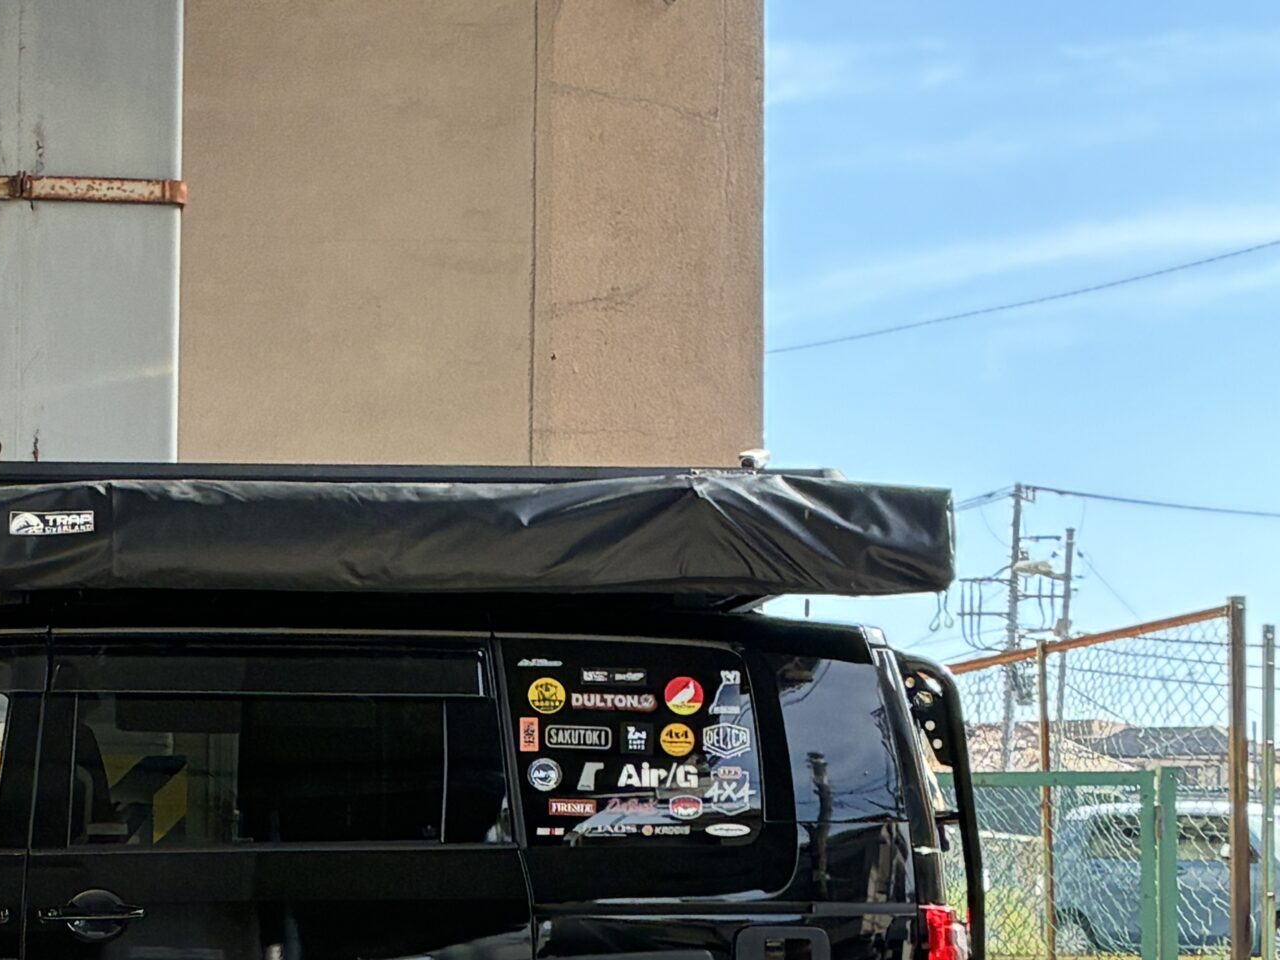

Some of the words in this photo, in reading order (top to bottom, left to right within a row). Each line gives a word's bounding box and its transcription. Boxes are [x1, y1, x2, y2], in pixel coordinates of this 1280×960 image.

[549, 728, 606, 746] SAKUTOKI
[706, 726, 747, 750] DELICA
[617, 761, 699, 789] Air/G
